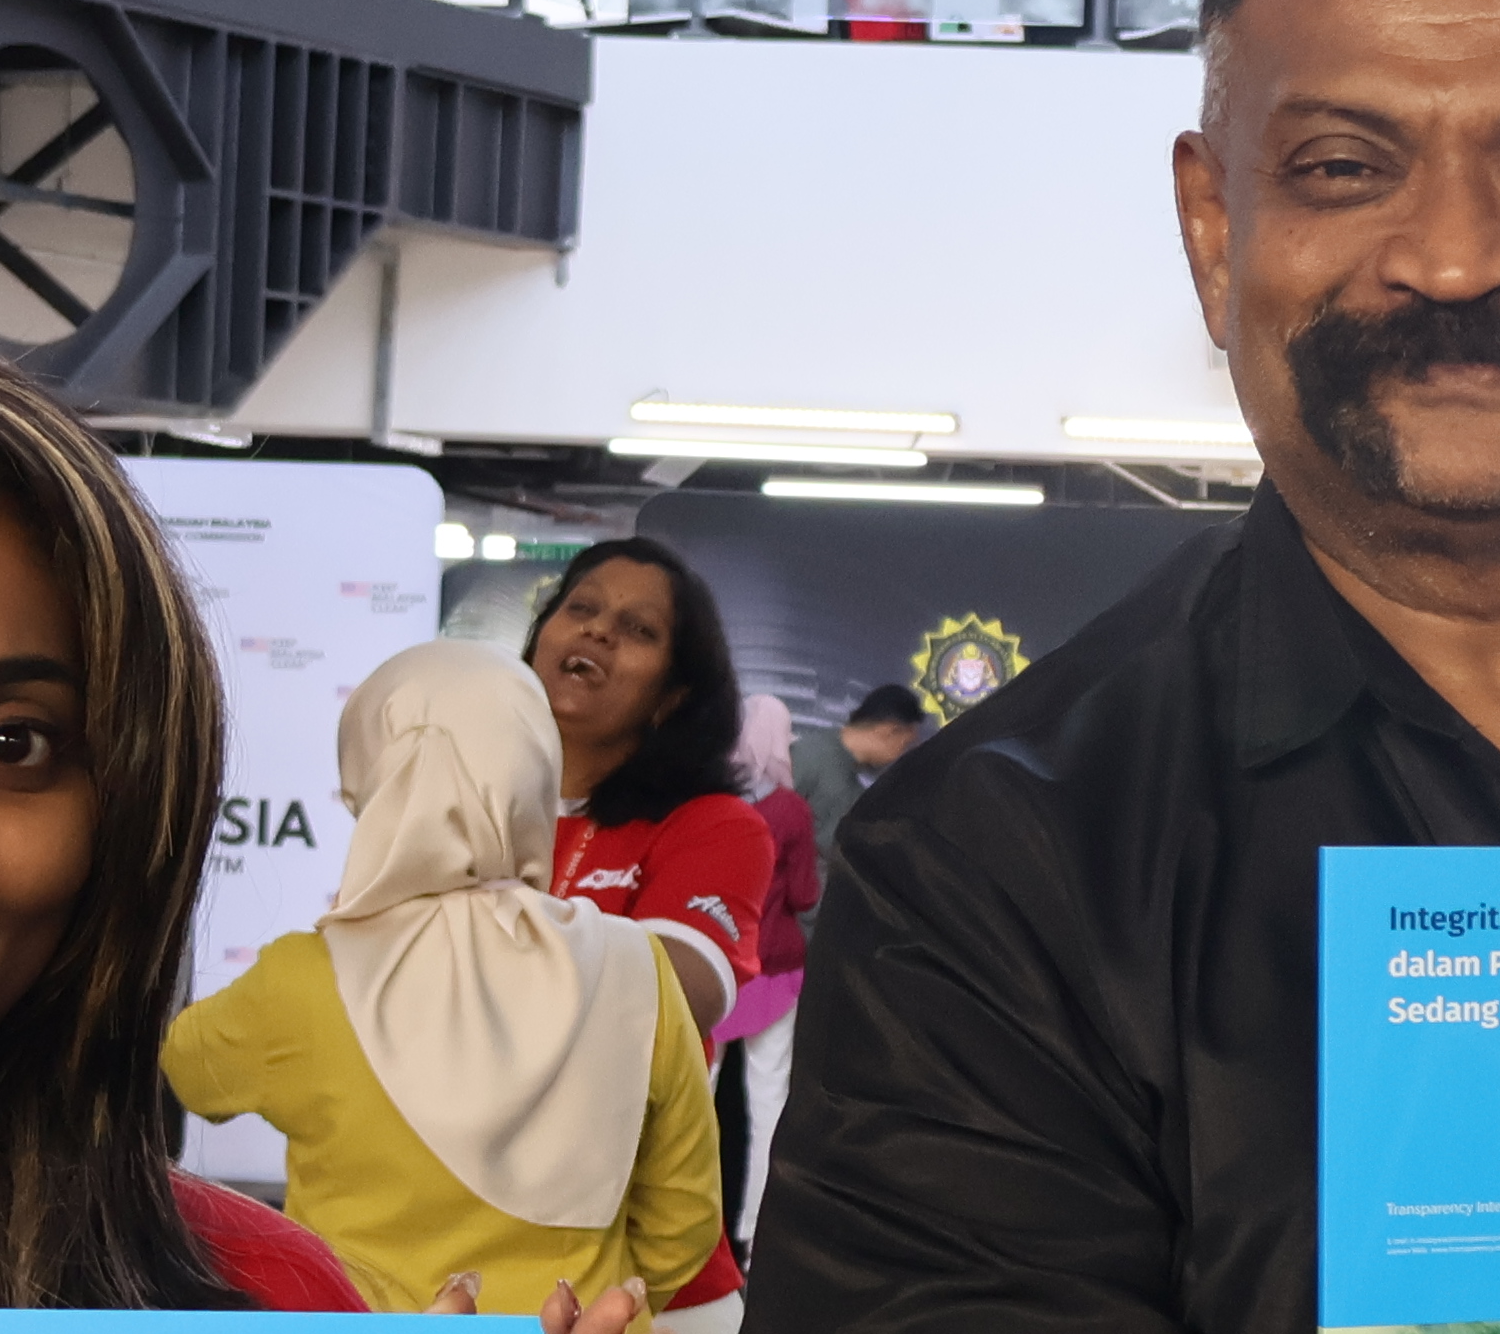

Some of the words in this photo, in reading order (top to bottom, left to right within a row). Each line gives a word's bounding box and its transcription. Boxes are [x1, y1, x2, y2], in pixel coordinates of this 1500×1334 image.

[1389, 950, 1481, 977] dalam
[1389, 996, 1500, 1028] Sedang
[1386, 1202, 1474, 1217] Transparency
